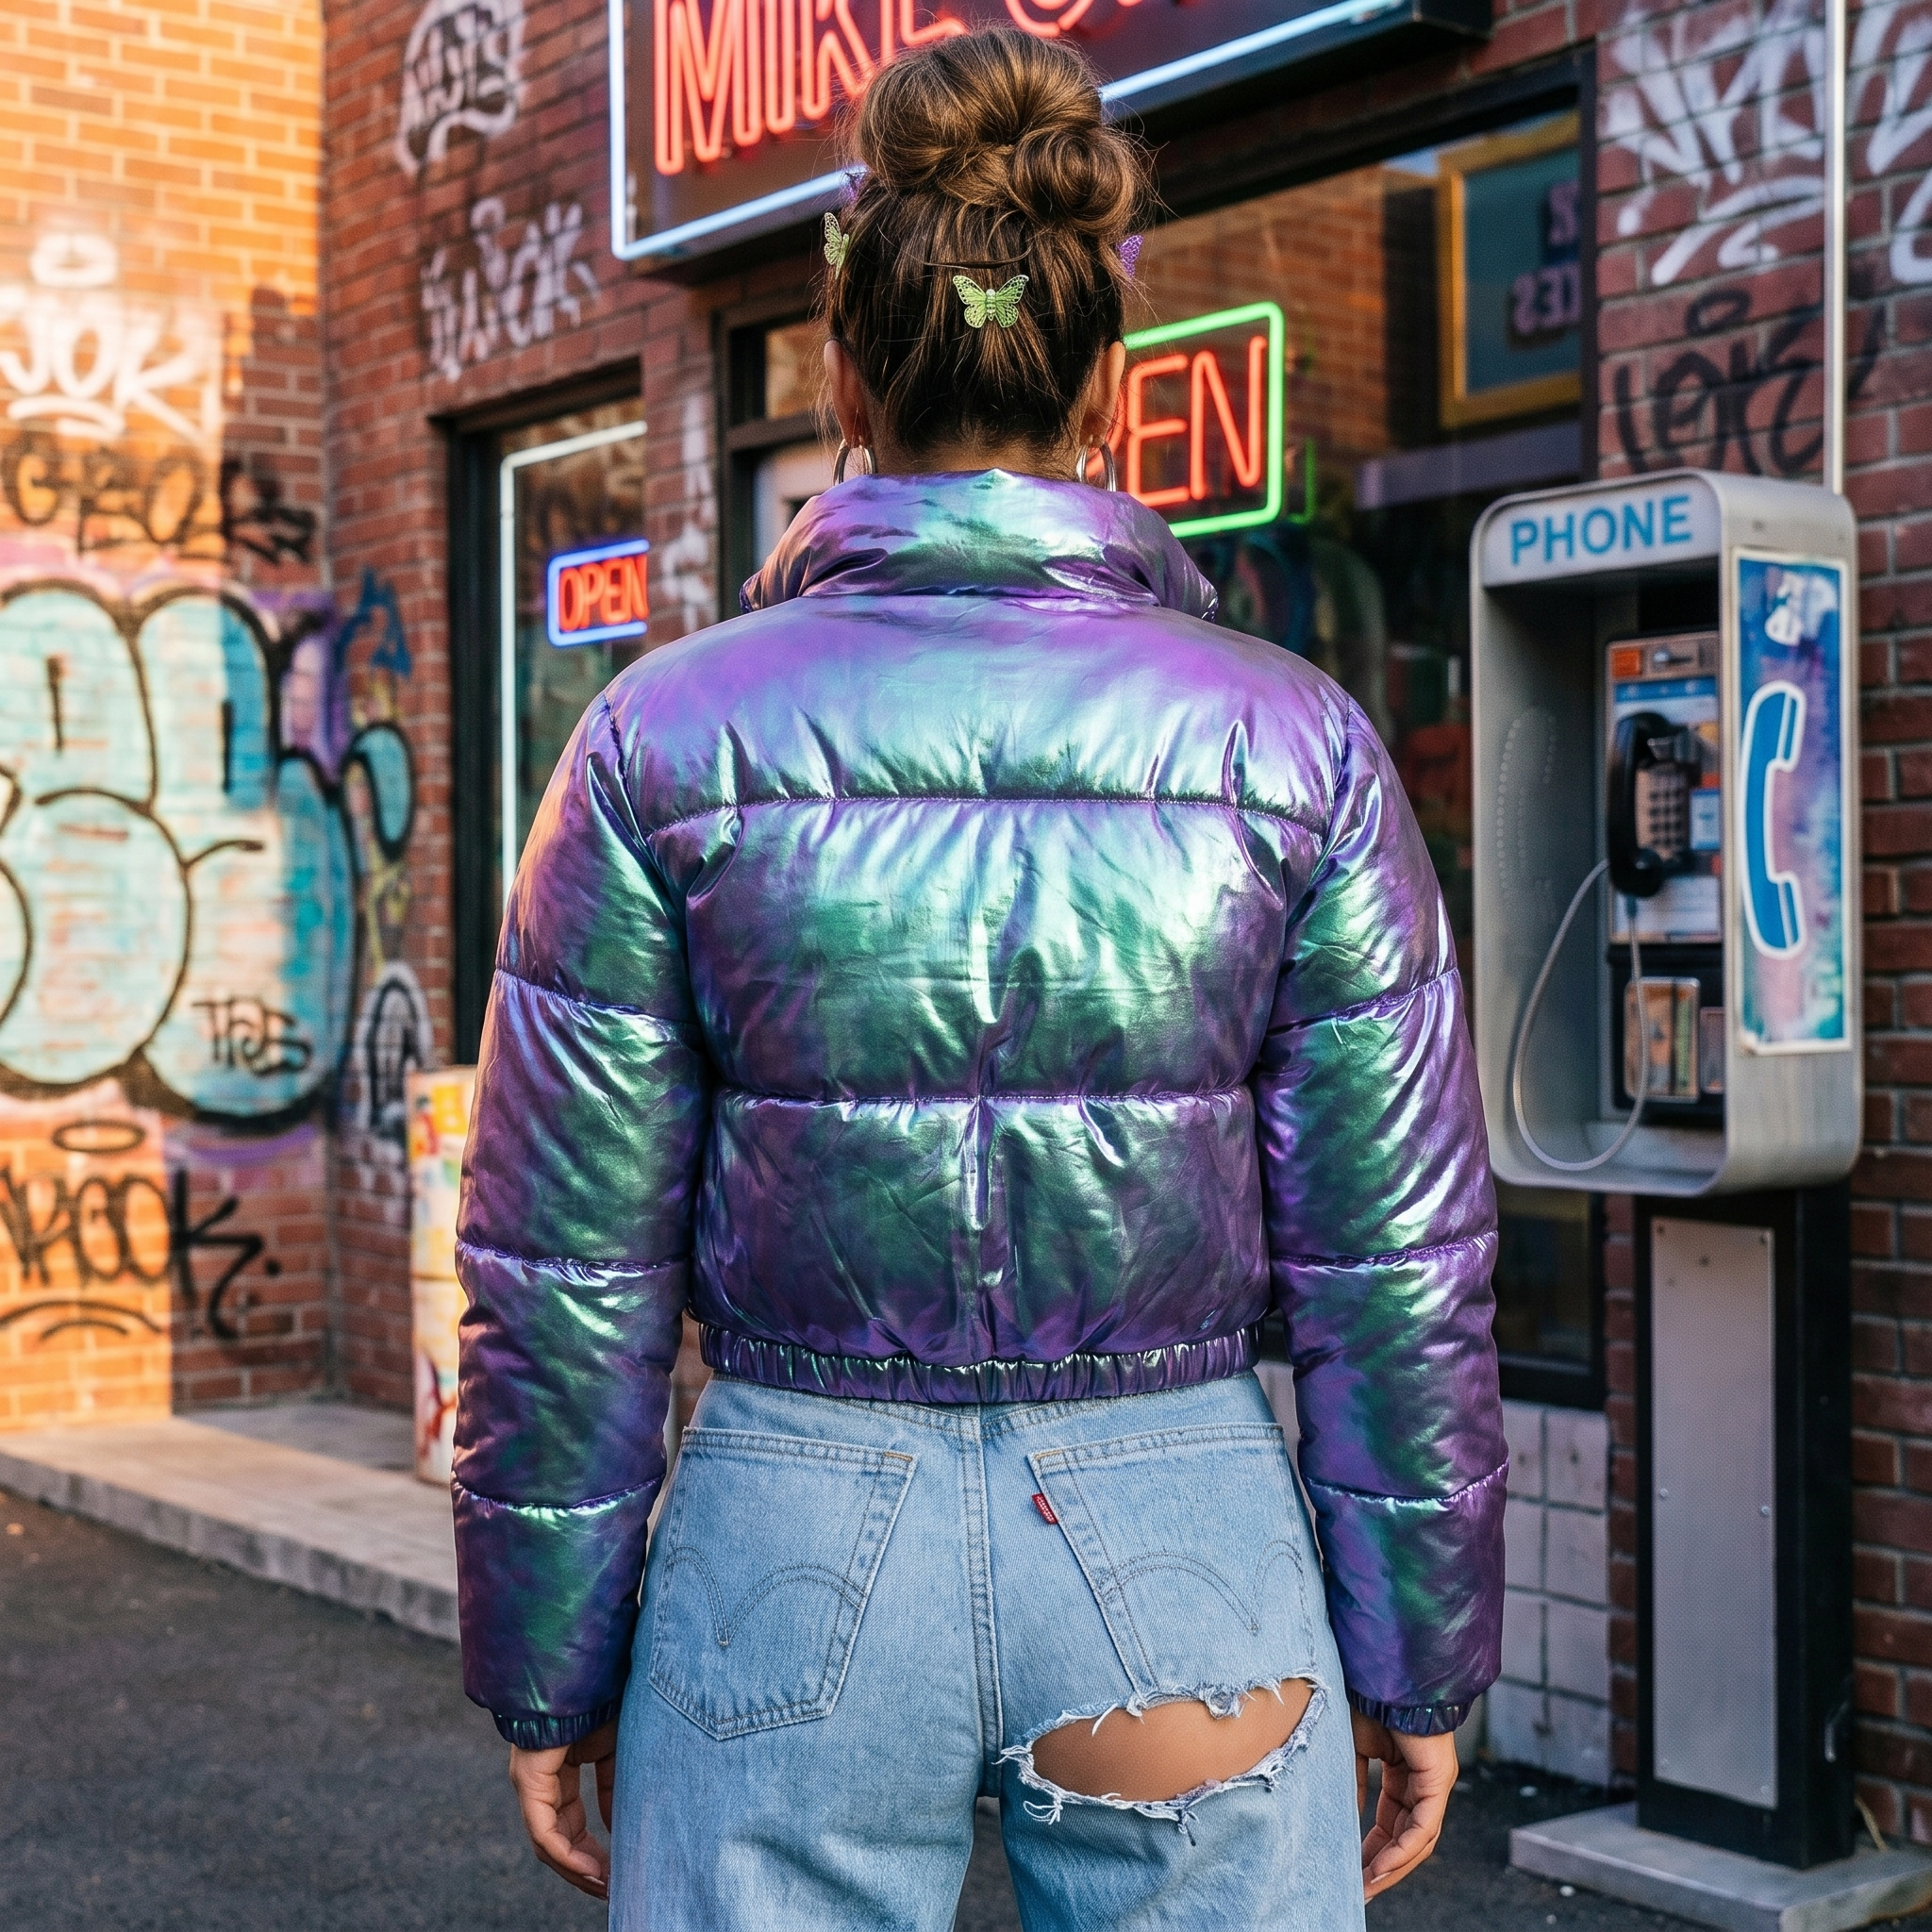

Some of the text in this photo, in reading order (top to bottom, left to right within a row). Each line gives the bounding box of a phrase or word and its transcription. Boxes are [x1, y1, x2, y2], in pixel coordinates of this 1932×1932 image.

[1086, 336, 1268, 508] EN
[1511, 494, 1692, 566] PHONE
[558, 554, 649, 632] OPEN
